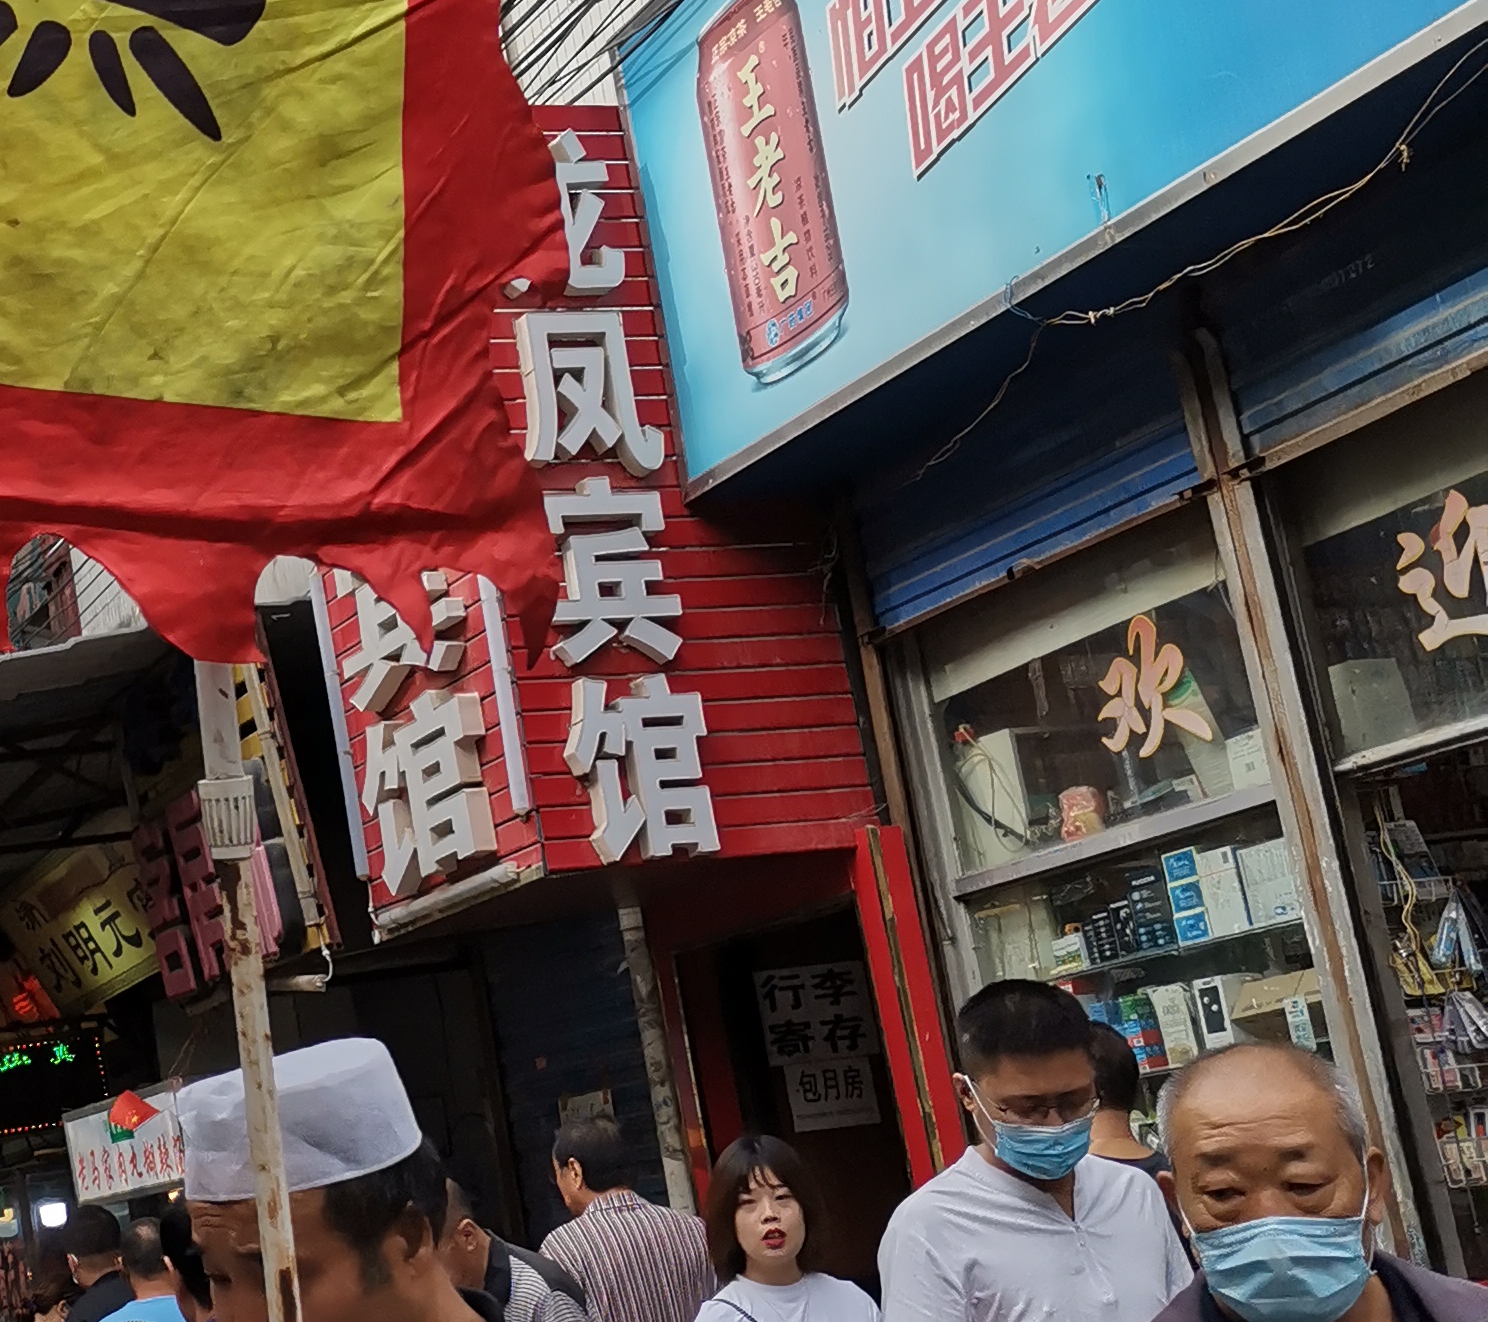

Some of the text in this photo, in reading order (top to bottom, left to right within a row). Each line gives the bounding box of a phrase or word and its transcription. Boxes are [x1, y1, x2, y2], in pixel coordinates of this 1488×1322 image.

[736, 54, 801, 305] 王老吉
[1097, 613, 1213, 758] 欢
[759, 967, 858, 1014] 行李
[768, 1014, 868, 1058] 寄存
[798, 1064, 865, 1104] 包月房
